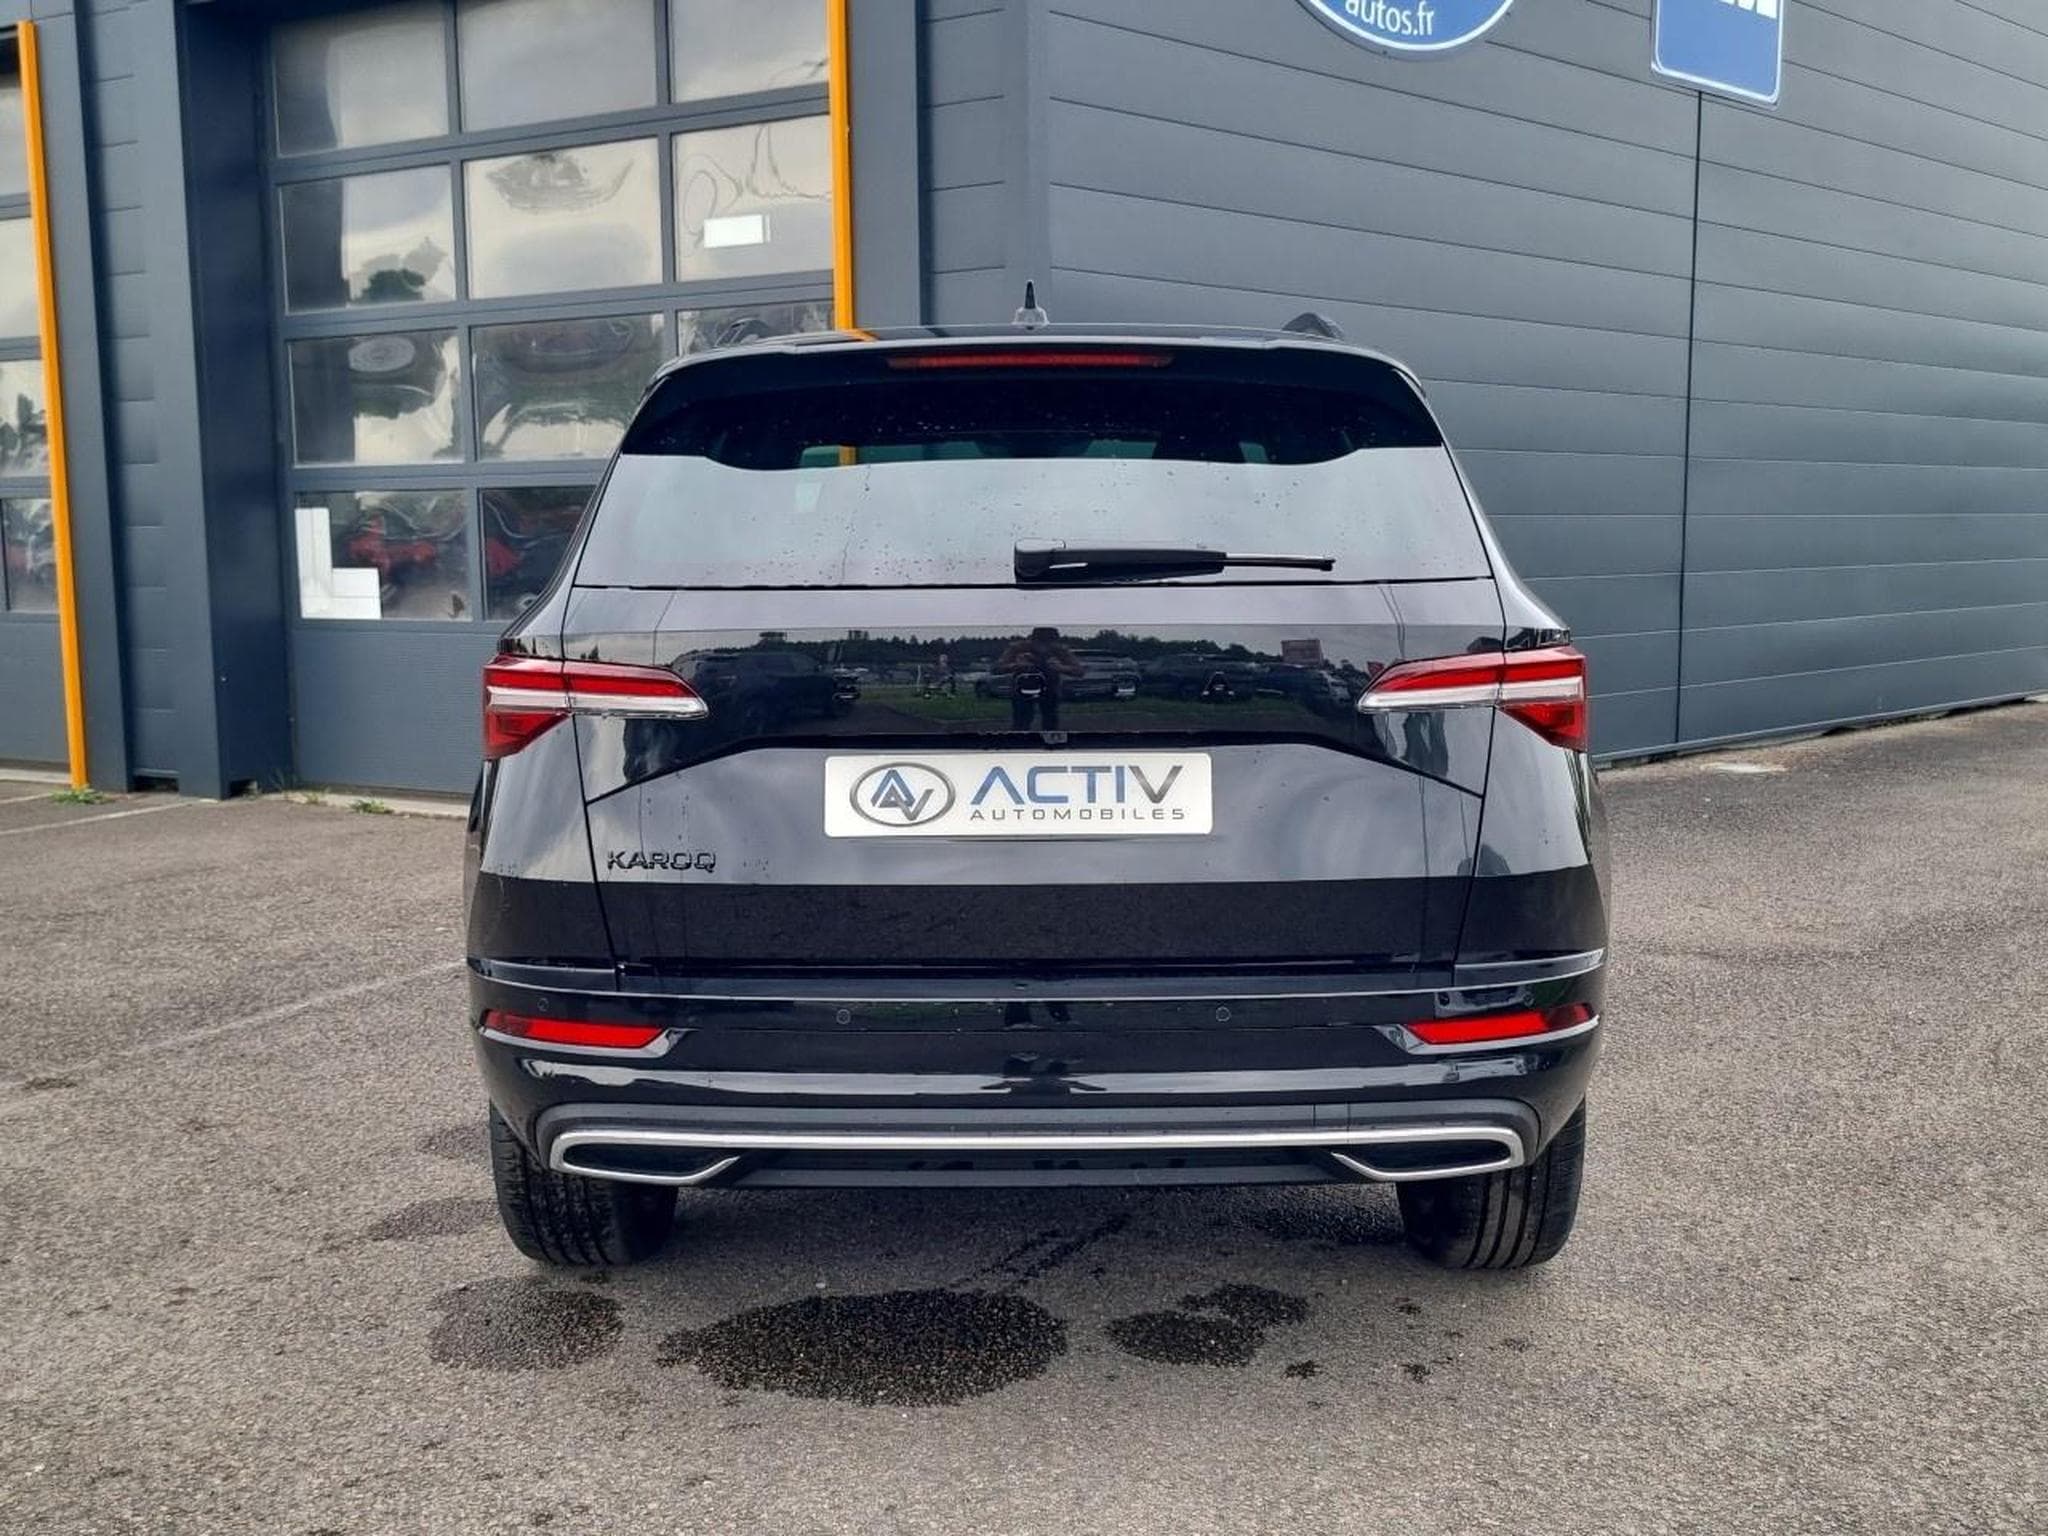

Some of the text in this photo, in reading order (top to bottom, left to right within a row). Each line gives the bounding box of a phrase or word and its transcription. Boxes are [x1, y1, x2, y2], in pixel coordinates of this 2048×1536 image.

[1345, 0, 1435, 36] autos.fr
[970, 765, 1183, 805] ACTIV
[970, 808, 1185, 821] AUTOMOBILES
[608, 851, 717, 873] KAROQ
